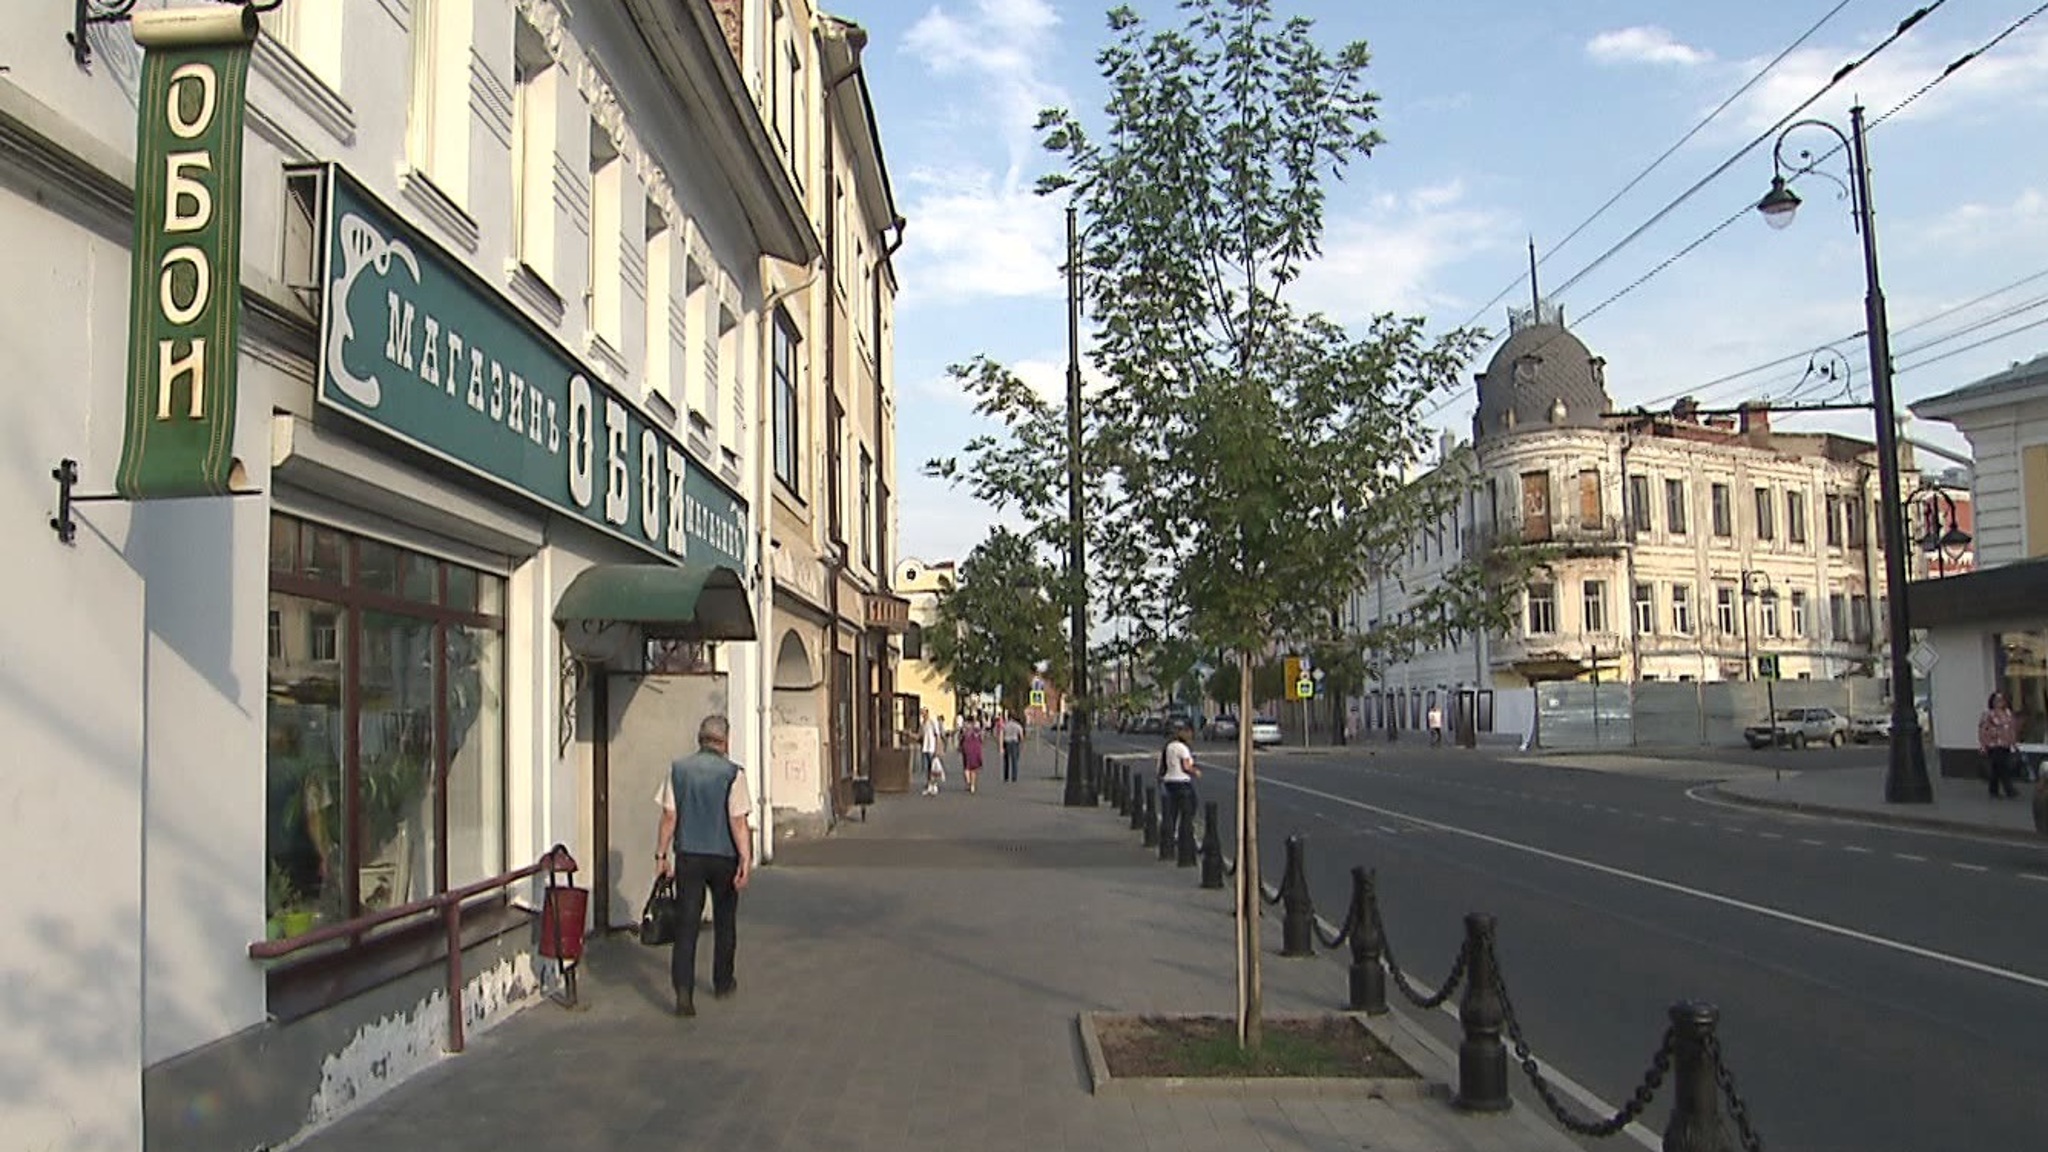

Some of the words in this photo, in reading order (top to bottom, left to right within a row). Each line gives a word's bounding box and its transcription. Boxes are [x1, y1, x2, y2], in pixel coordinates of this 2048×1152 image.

[157, 63, 217, 420] ОБОИ
[385, 289, 560, 454] МАГАЗИНЪ
[569, 374, 687, 557] ОБОИ
